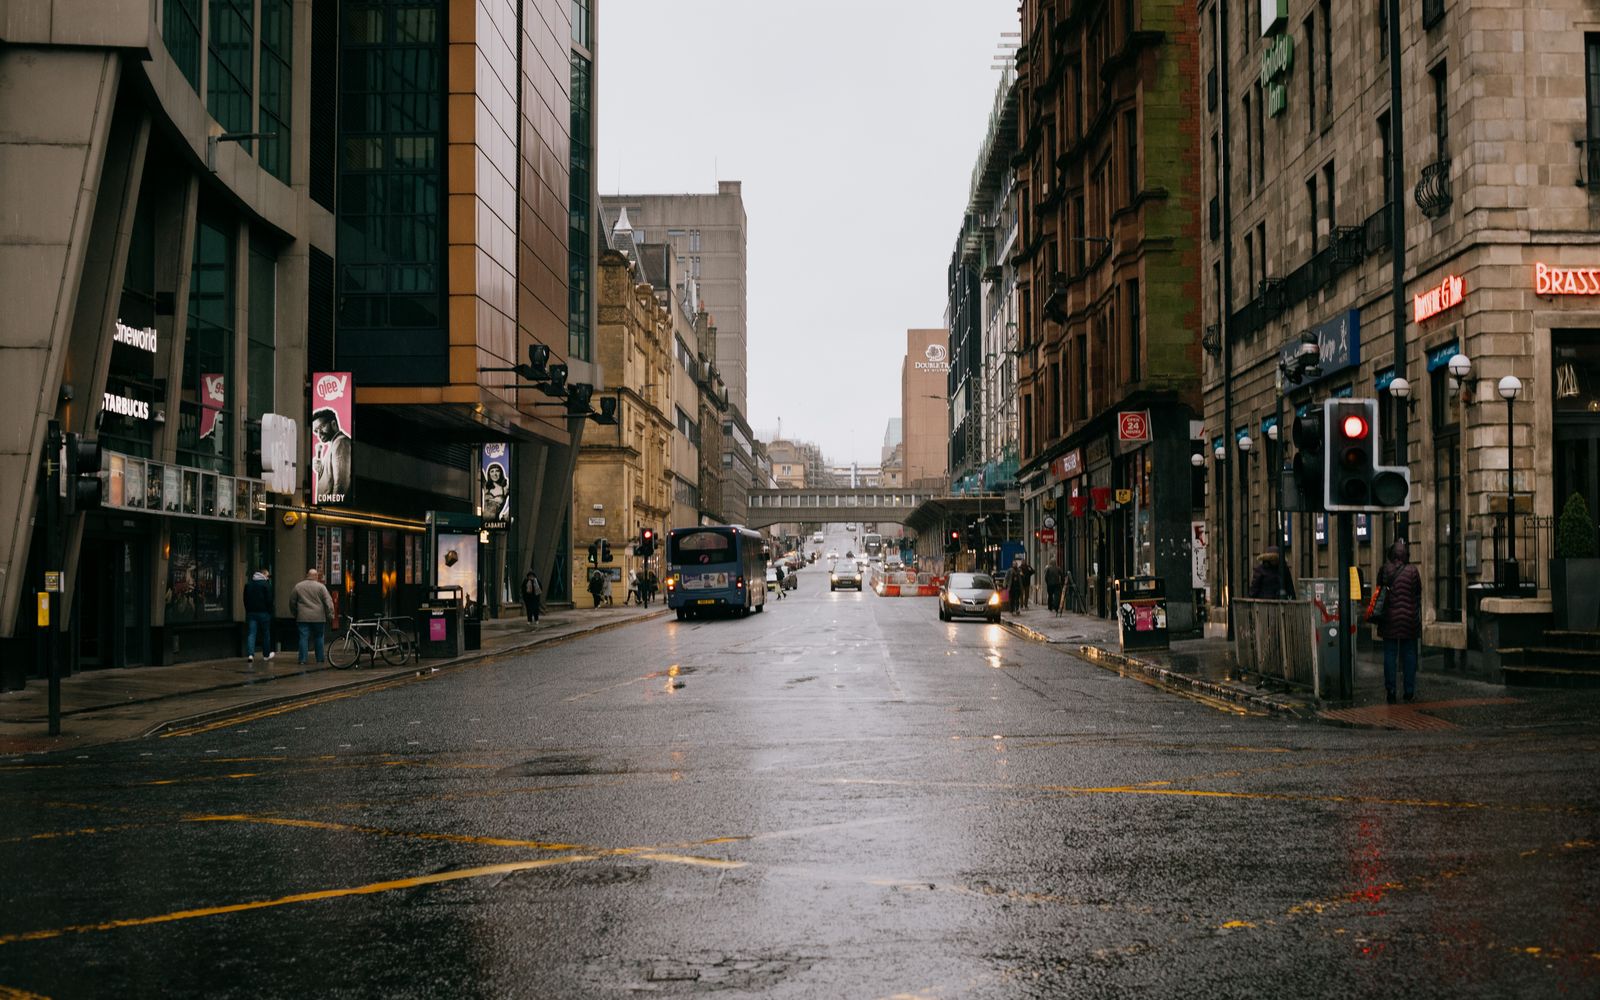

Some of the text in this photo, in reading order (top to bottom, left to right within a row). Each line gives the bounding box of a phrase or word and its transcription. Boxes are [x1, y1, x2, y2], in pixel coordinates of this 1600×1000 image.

[1261, 34, 1288, 88] Holiday
[1269, 81, 1281, 119] Inn
[102, 393, 149, 420] TARBUCKS
[1127, 422, 1140, 430] 24
[318, 493, 345, 502] COMEDY
